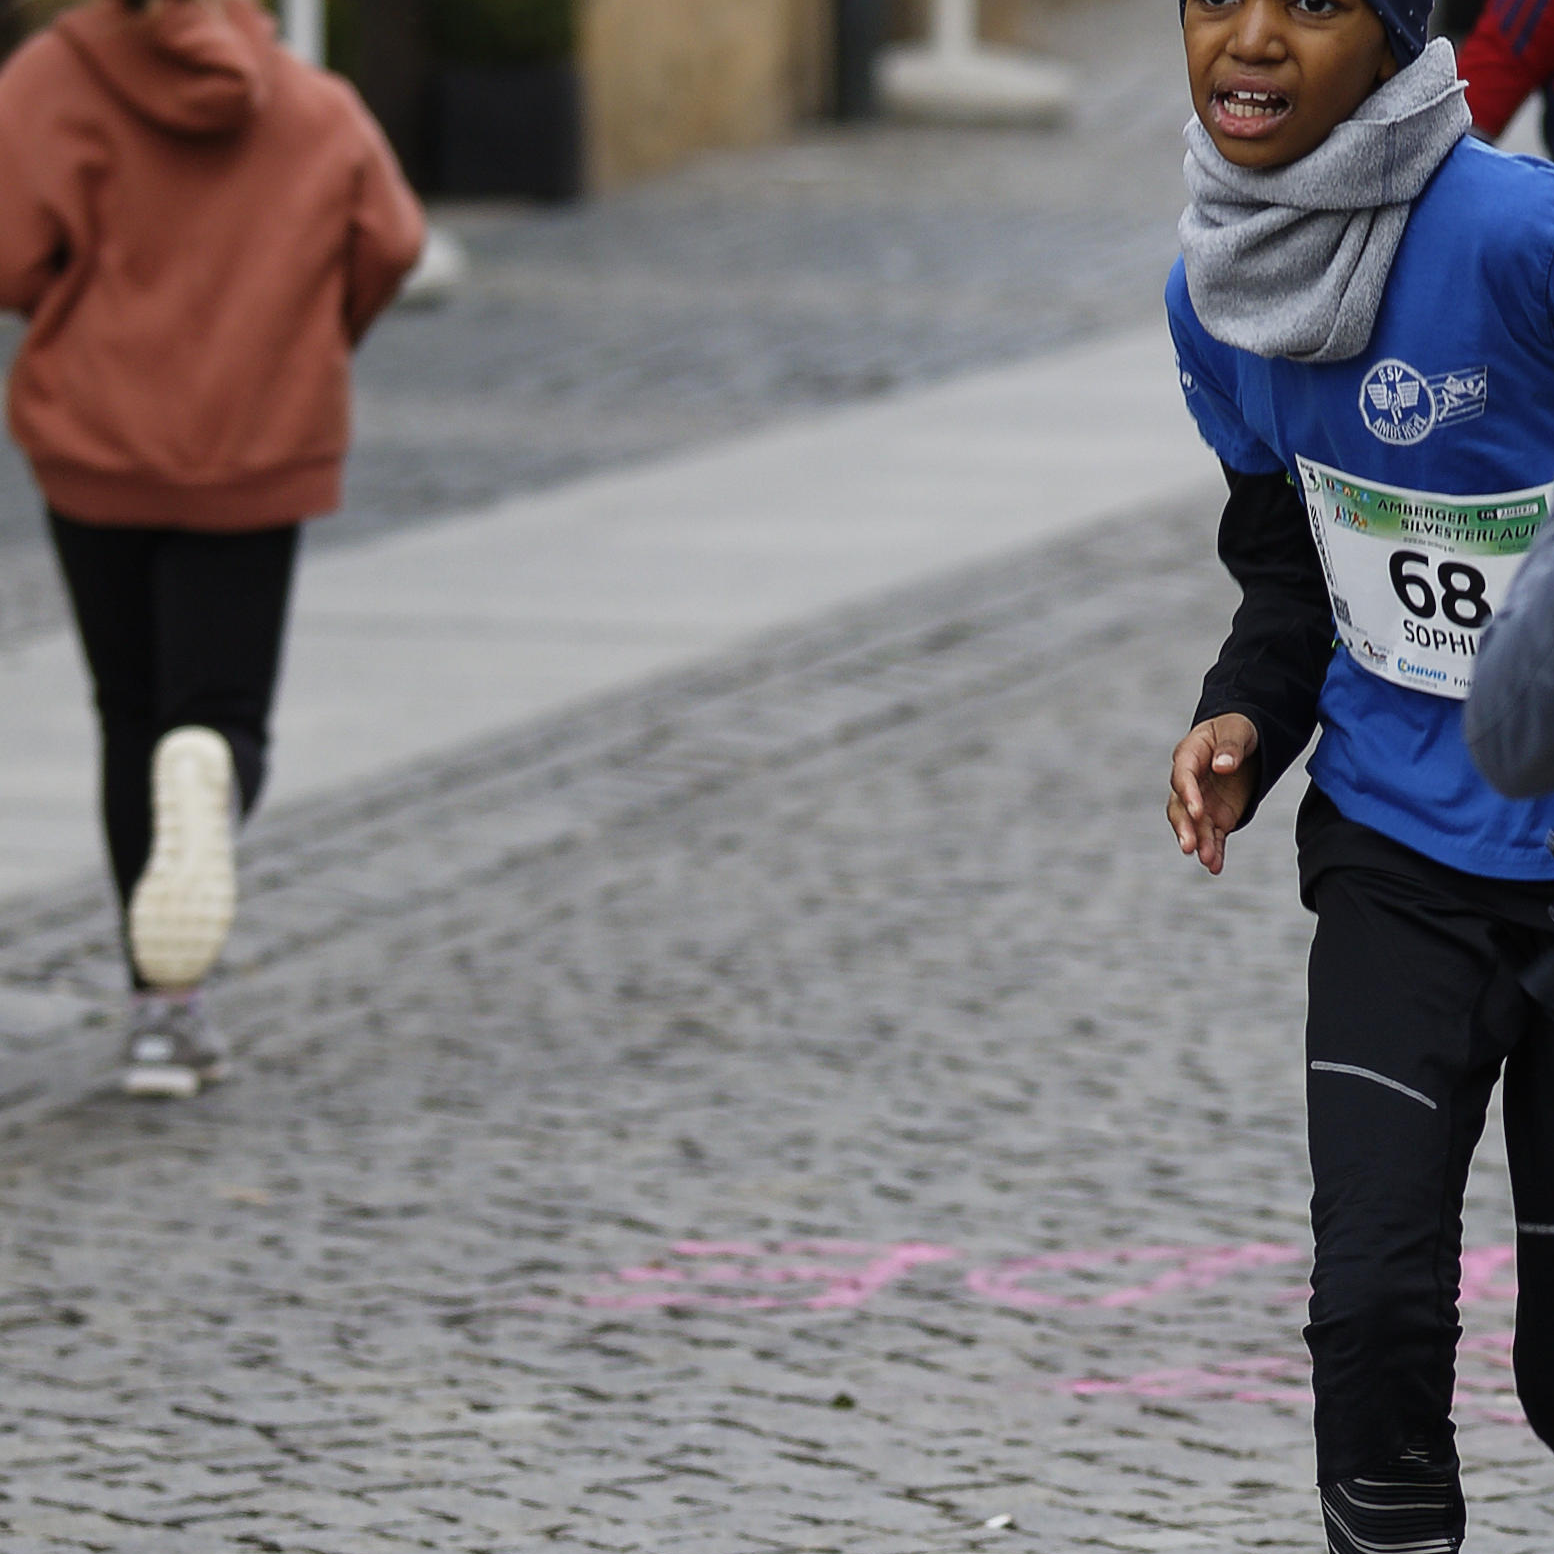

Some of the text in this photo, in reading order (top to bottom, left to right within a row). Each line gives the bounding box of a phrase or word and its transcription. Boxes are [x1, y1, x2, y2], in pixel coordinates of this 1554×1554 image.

[1378, 366, 1403, 384] ESV
[1378, 499, 1468, 527] AMBERGER
[1403, 619, 1477, 656] SOPHI
